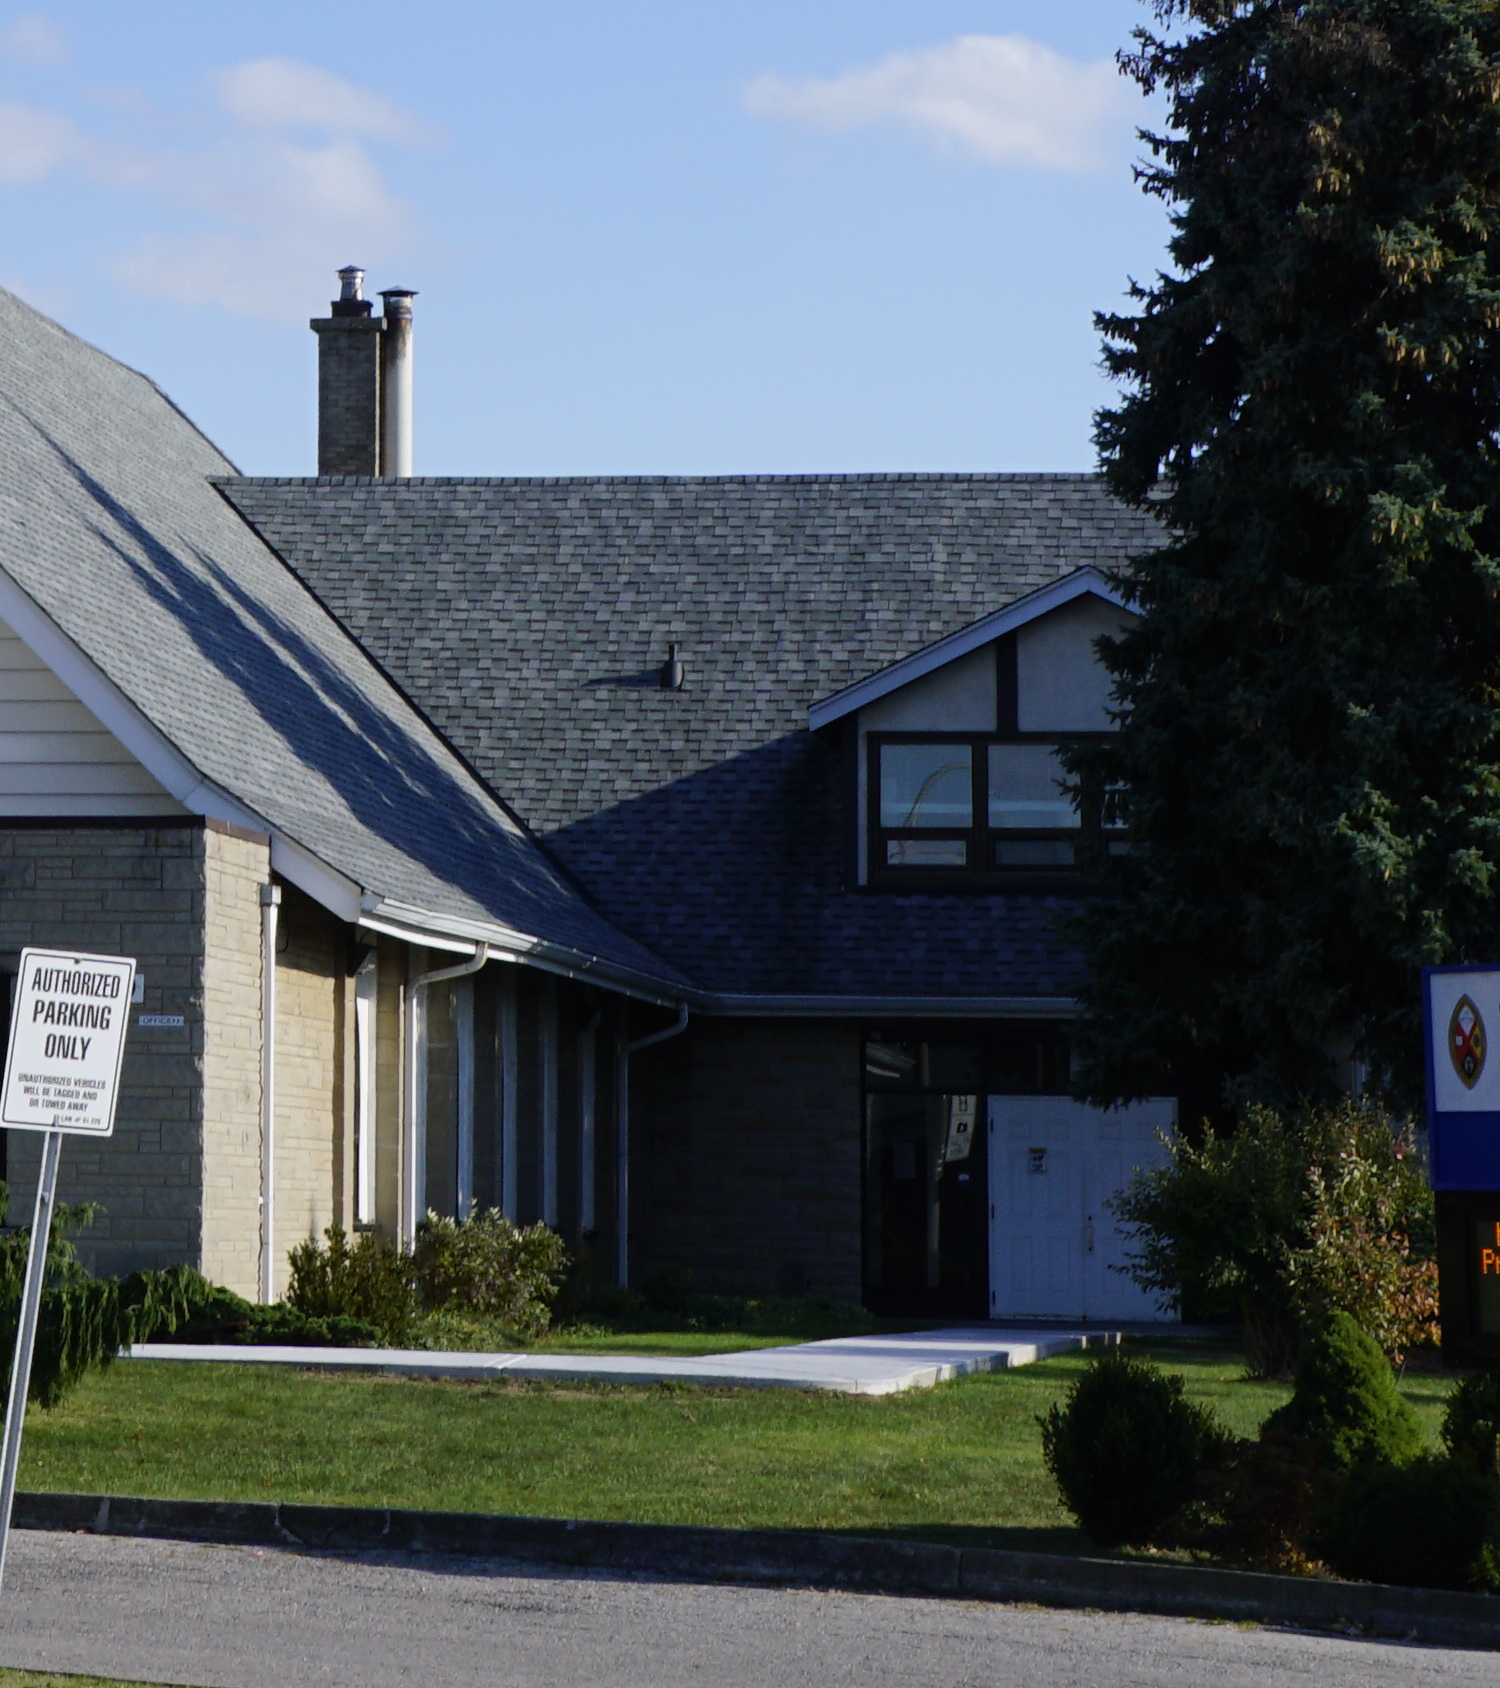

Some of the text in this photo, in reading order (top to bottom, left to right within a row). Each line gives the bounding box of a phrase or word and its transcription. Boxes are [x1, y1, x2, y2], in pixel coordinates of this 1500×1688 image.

[31, 966, 121, 999] AUTHORIZED
[32, 999, 112, 1031] PARKING
[44, 1033, 92, 1061] ONLY
[18, 1073, 71, 1086] UNAUTHORIZED
[23, 1085, 39, 1096] WILL
[82, 1091, 97, 1101] AND
[67, 1101, 88, 1112] AWAY
